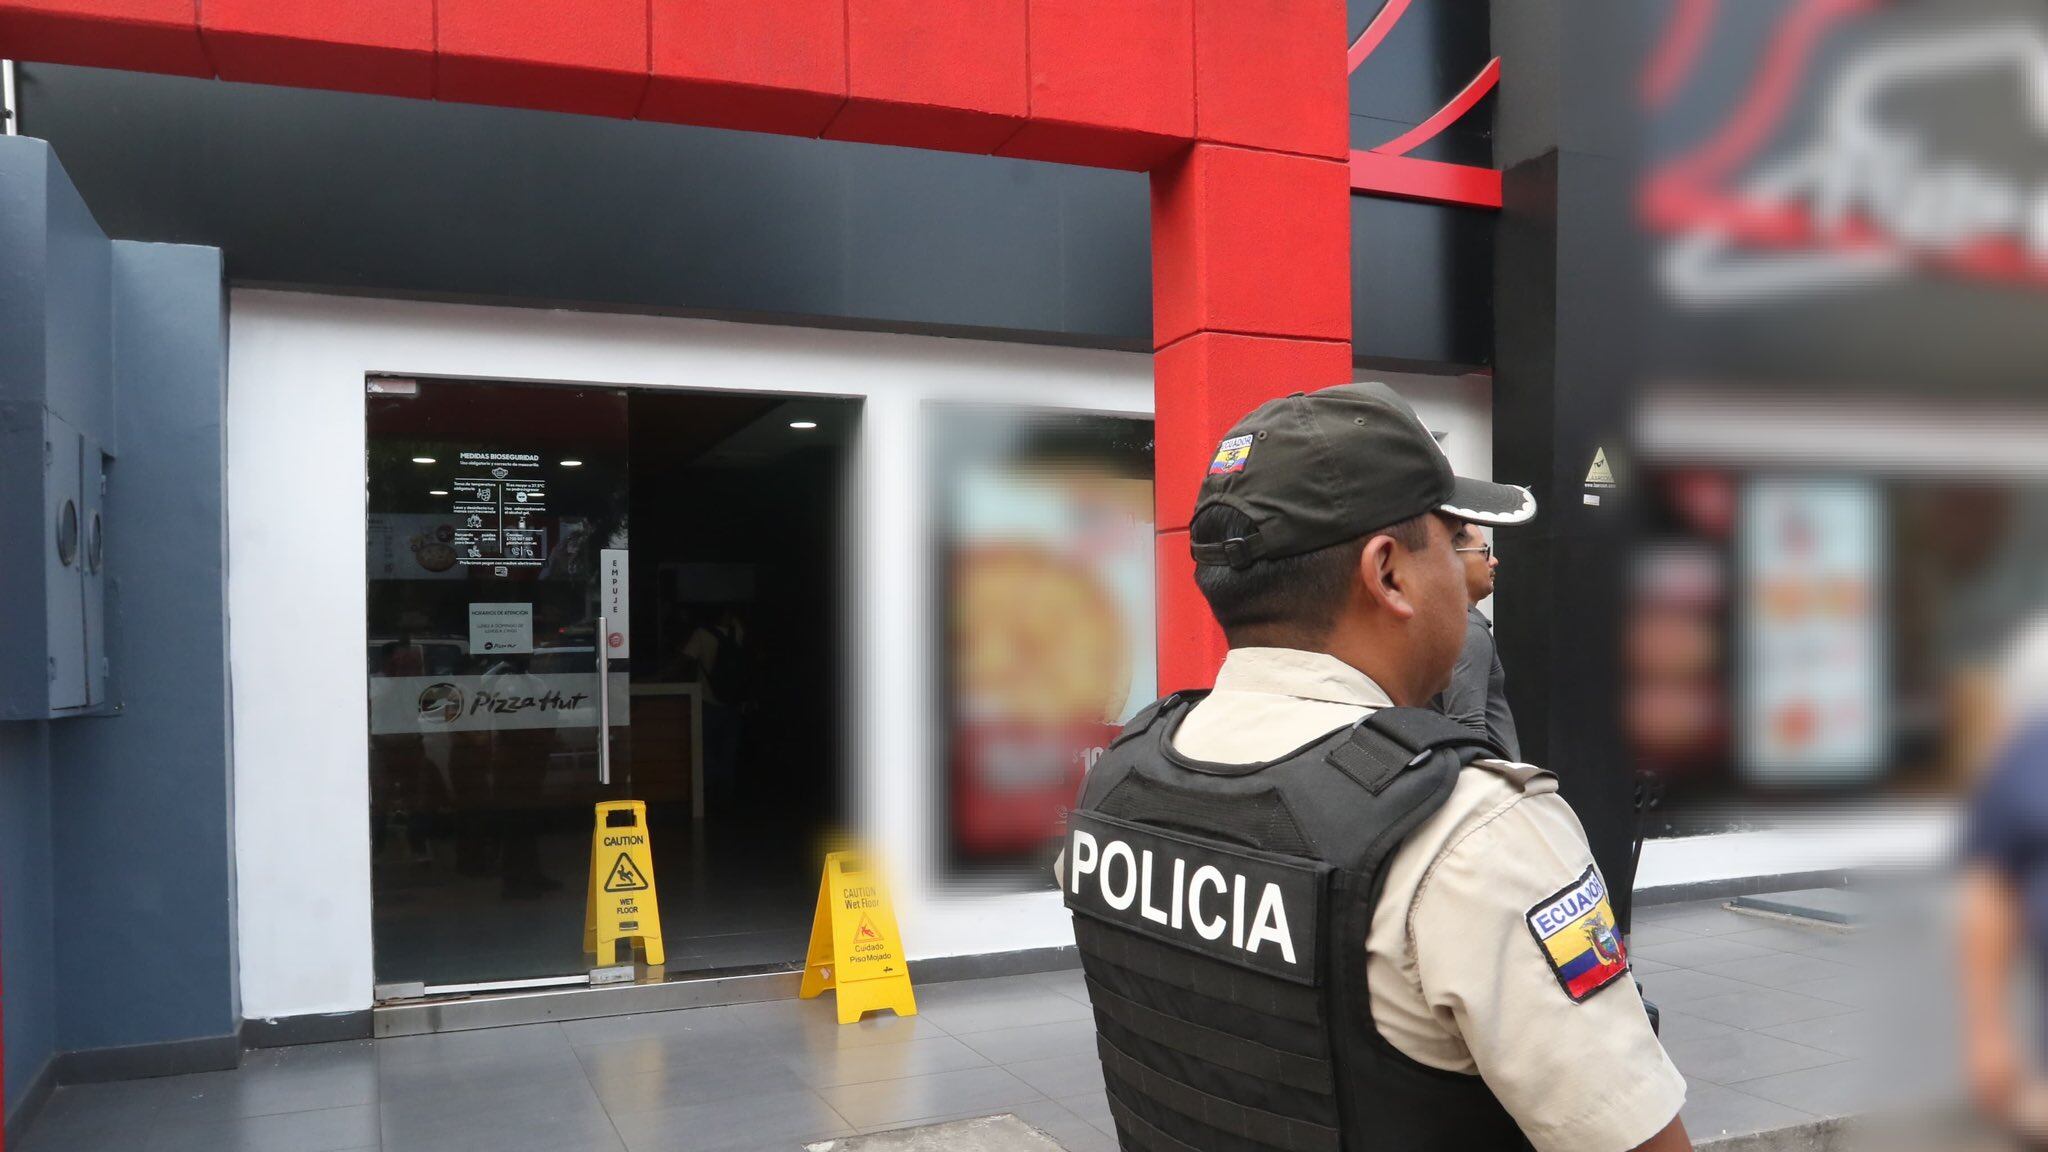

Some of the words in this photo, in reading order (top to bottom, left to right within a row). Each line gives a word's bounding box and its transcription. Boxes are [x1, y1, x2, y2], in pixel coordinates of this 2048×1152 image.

[490, 453, 539, 461] BIOSEGURIDAD
[611, 560, 619, 613] EMPUJE
[470, 691, 535, 715] Pizza
[539, 690, 588, 711] Hut
[604, 836, 644, 846] CAUTION
[843, 886, 877, 898] CAUTION
[1072, 830, 1297, 964] POLICIA
[845, 899, 860, 909] Wet
[855, 943, 884, 952] Cuidado
[866, 953, 892, 962] Mojado
